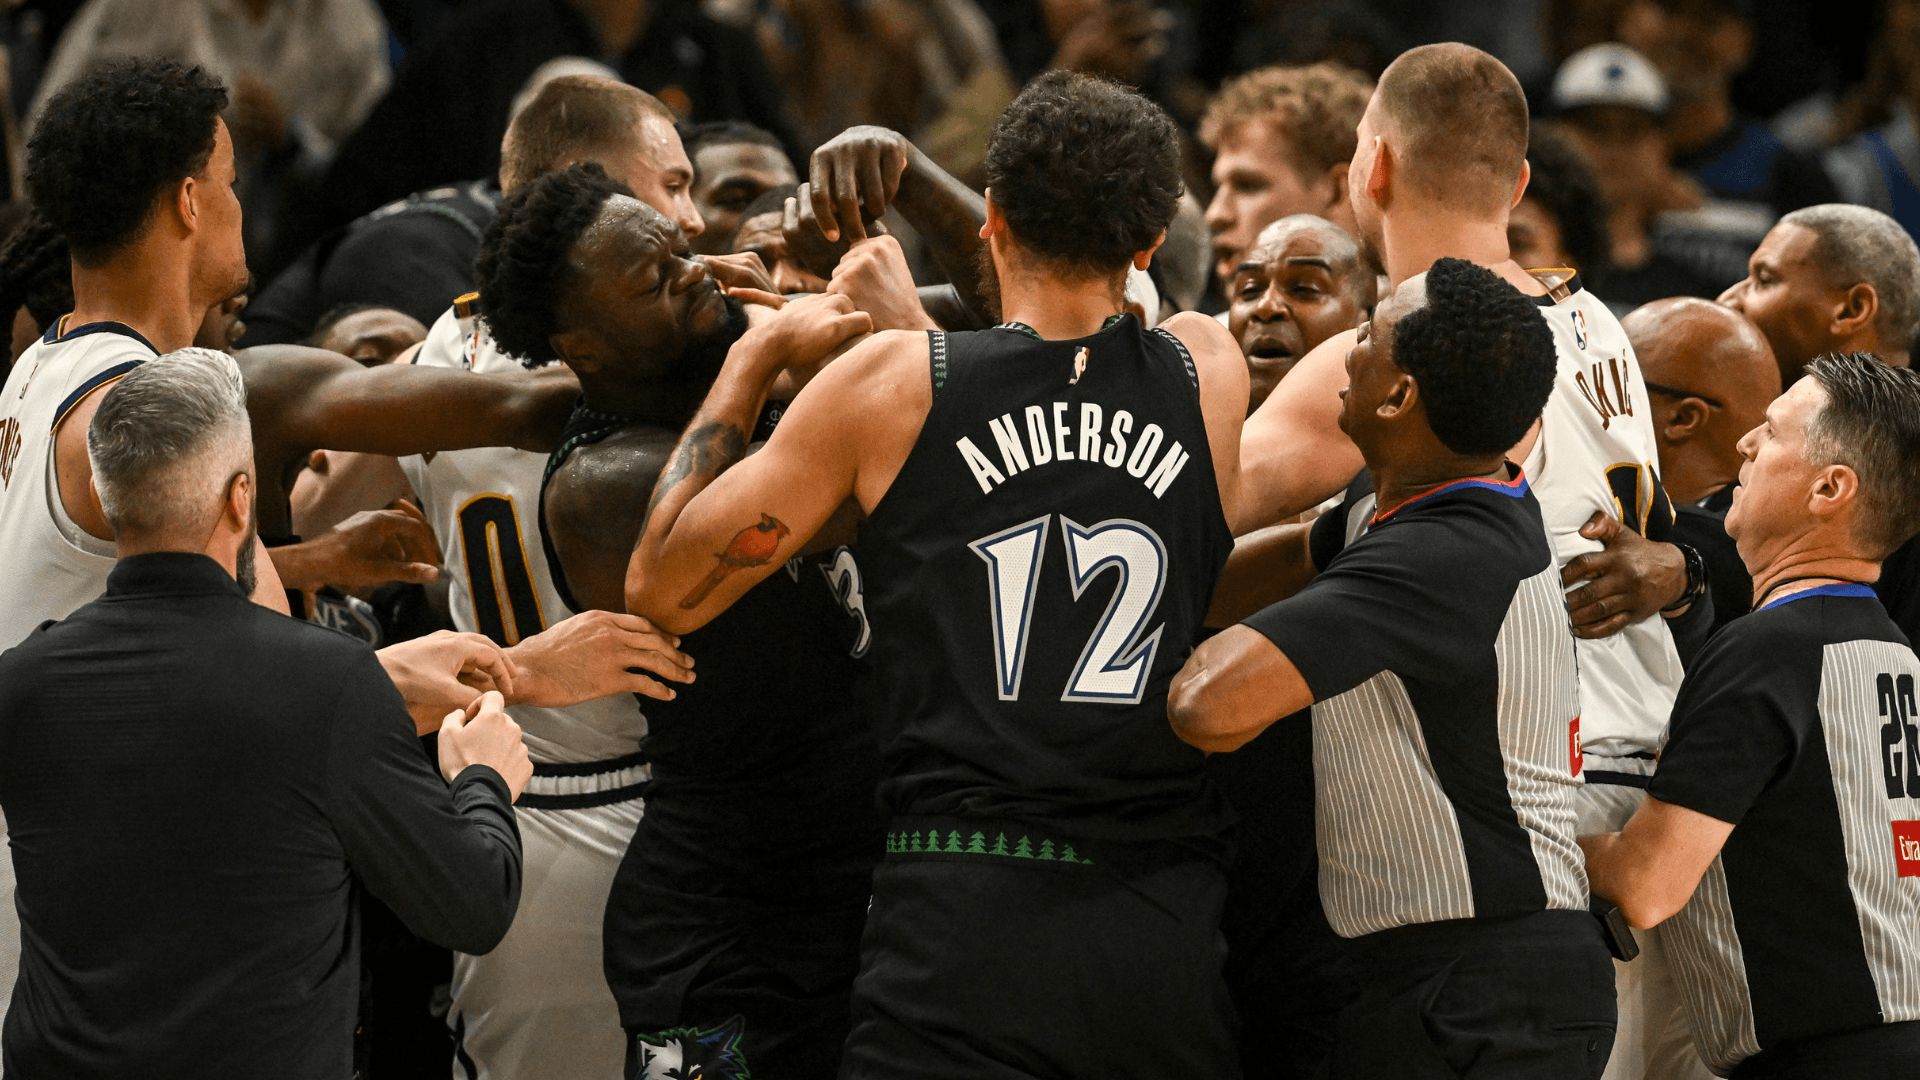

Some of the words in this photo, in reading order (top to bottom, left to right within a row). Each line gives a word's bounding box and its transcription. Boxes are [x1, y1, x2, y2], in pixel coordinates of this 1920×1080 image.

[956, 402, 1190, 499] ANDERSON
[456, 492, 548, 648] 0
[967, 513, 1168, 704] 12
[1876, 672, 1920, 799] 26
